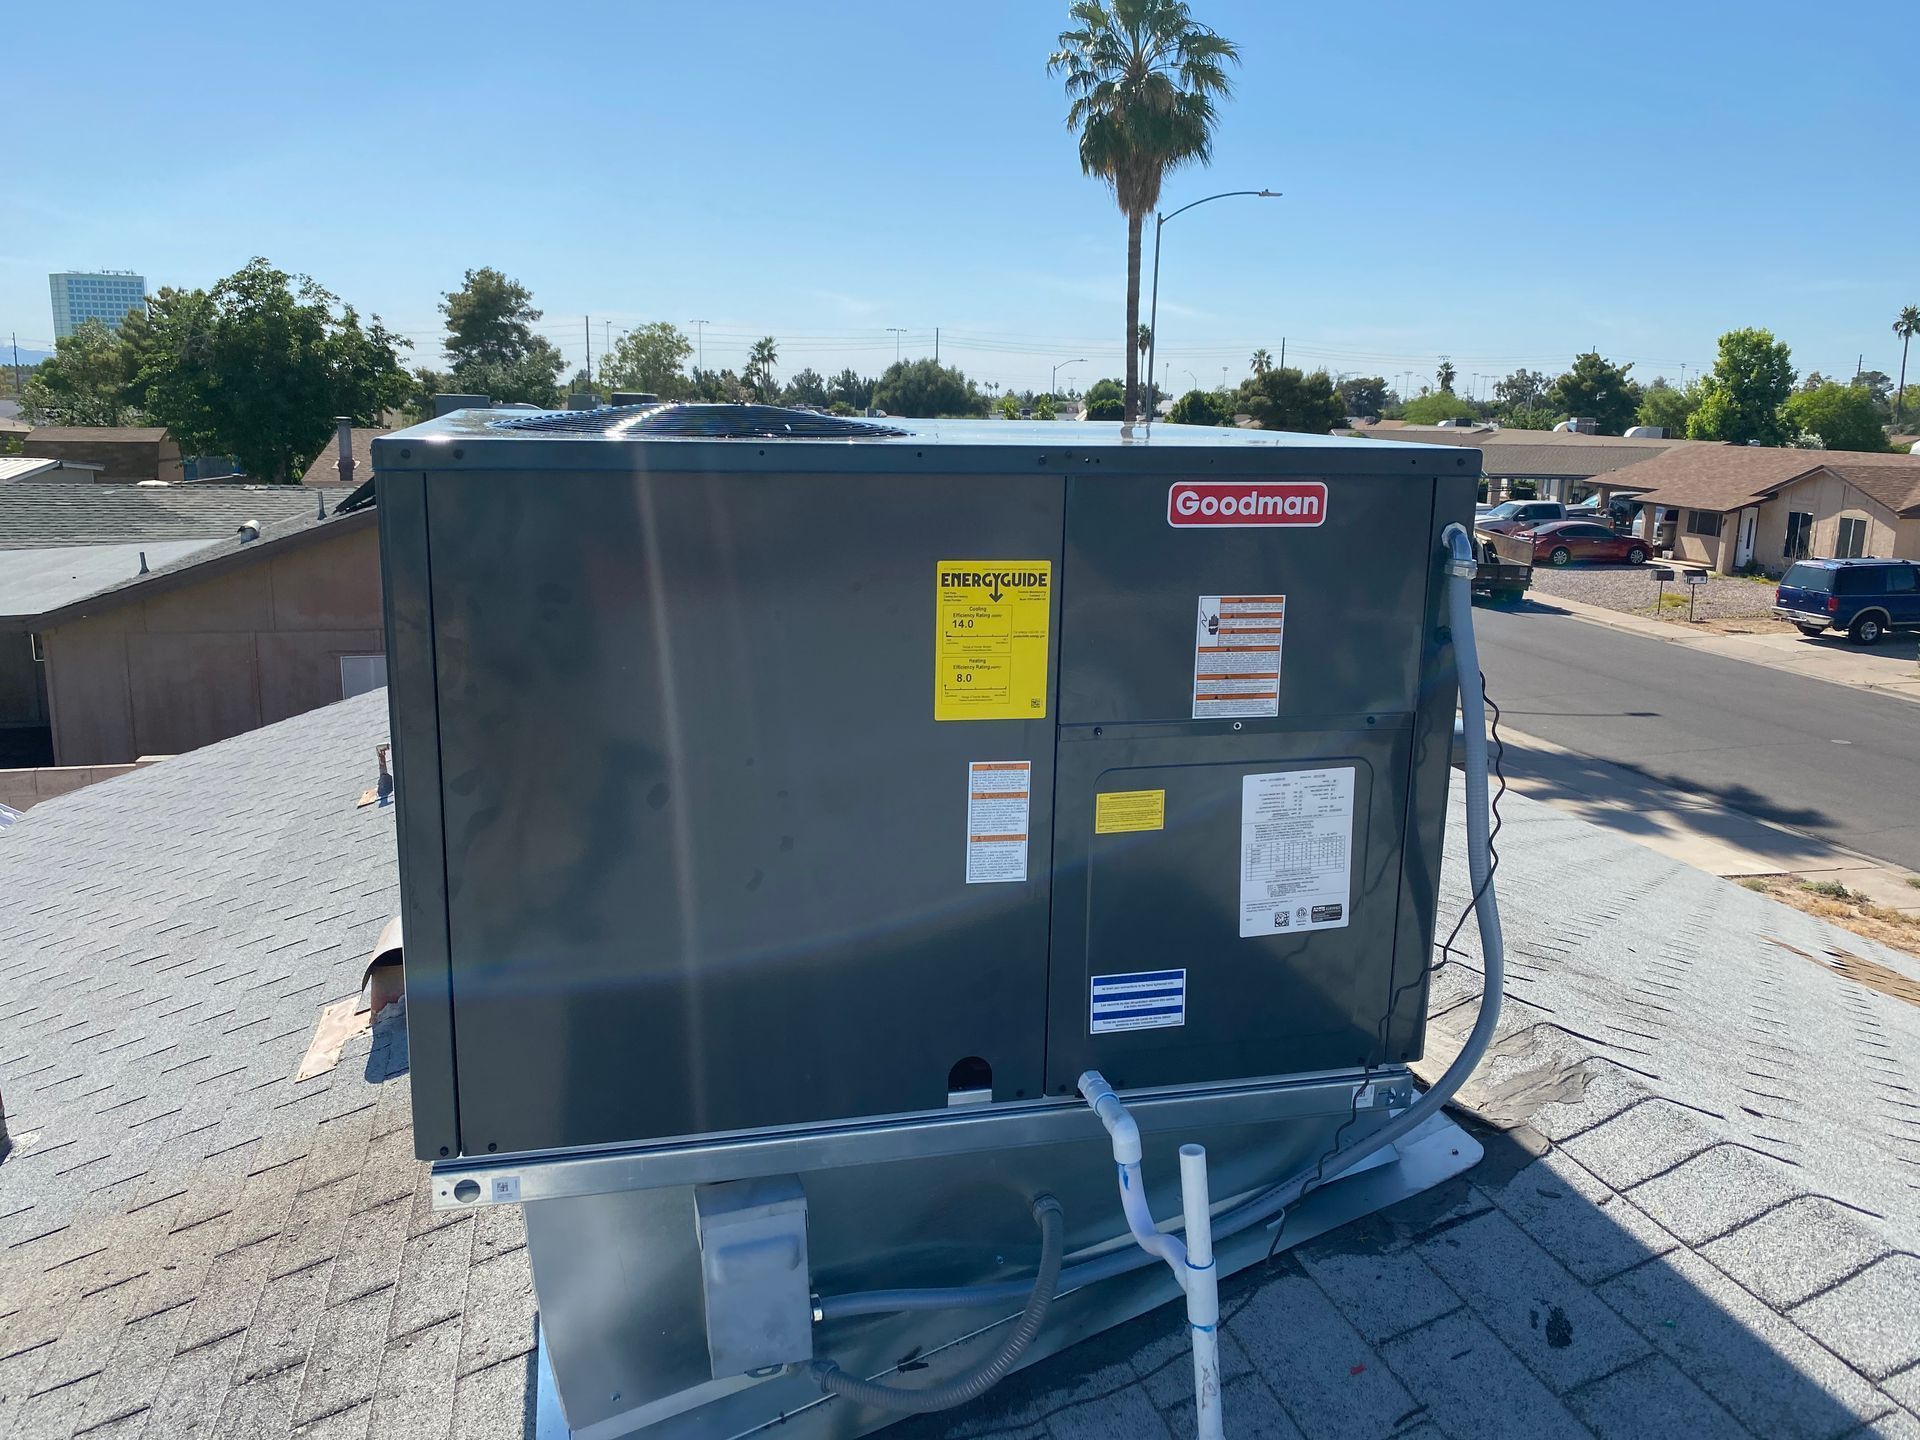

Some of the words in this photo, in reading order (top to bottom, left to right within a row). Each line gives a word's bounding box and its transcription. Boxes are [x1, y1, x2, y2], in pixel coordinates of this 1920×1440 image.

[1176, 490, 1319, 516] Goodman
[941, 572, 1048, 588] ENERGYGUIDE
[952, 619, 974, 629] 14.0
[956, 673, 972, 683] 8.0
